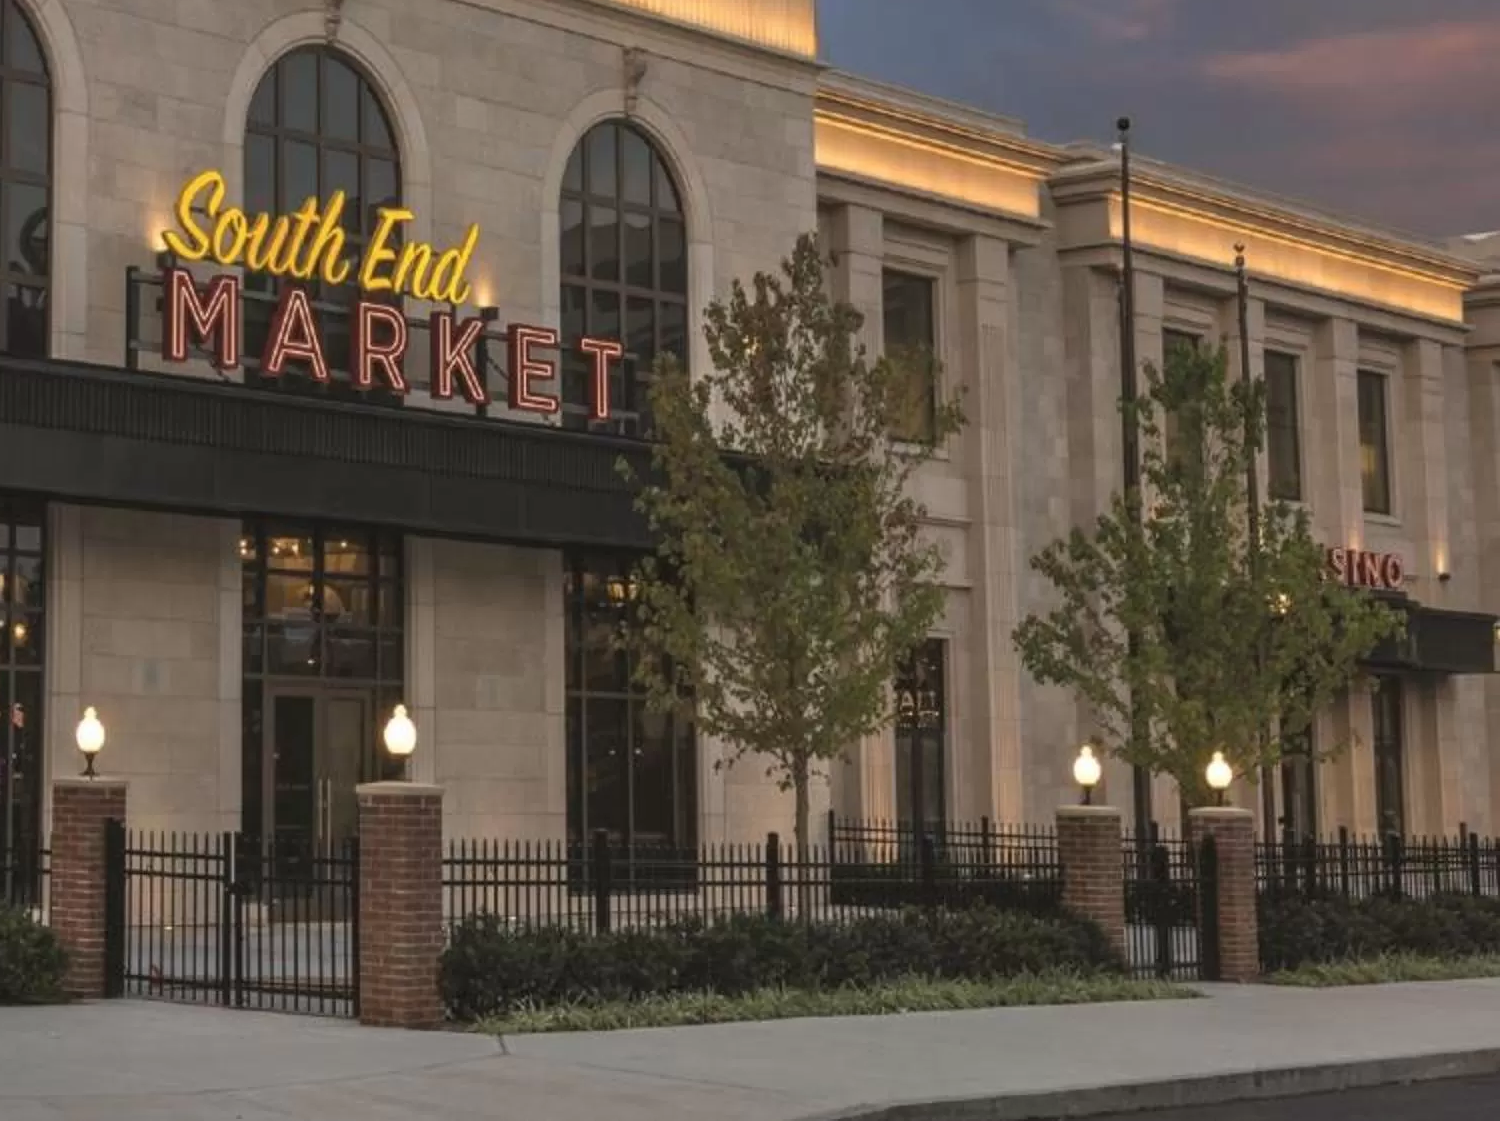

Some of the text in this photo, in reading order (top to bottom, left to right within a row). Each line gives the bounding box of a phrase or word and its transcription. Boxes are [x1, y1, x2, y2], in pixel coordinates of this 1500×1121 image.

[162, 170, 479, 303] South End
[164, 268, 624, 422] MARKET
